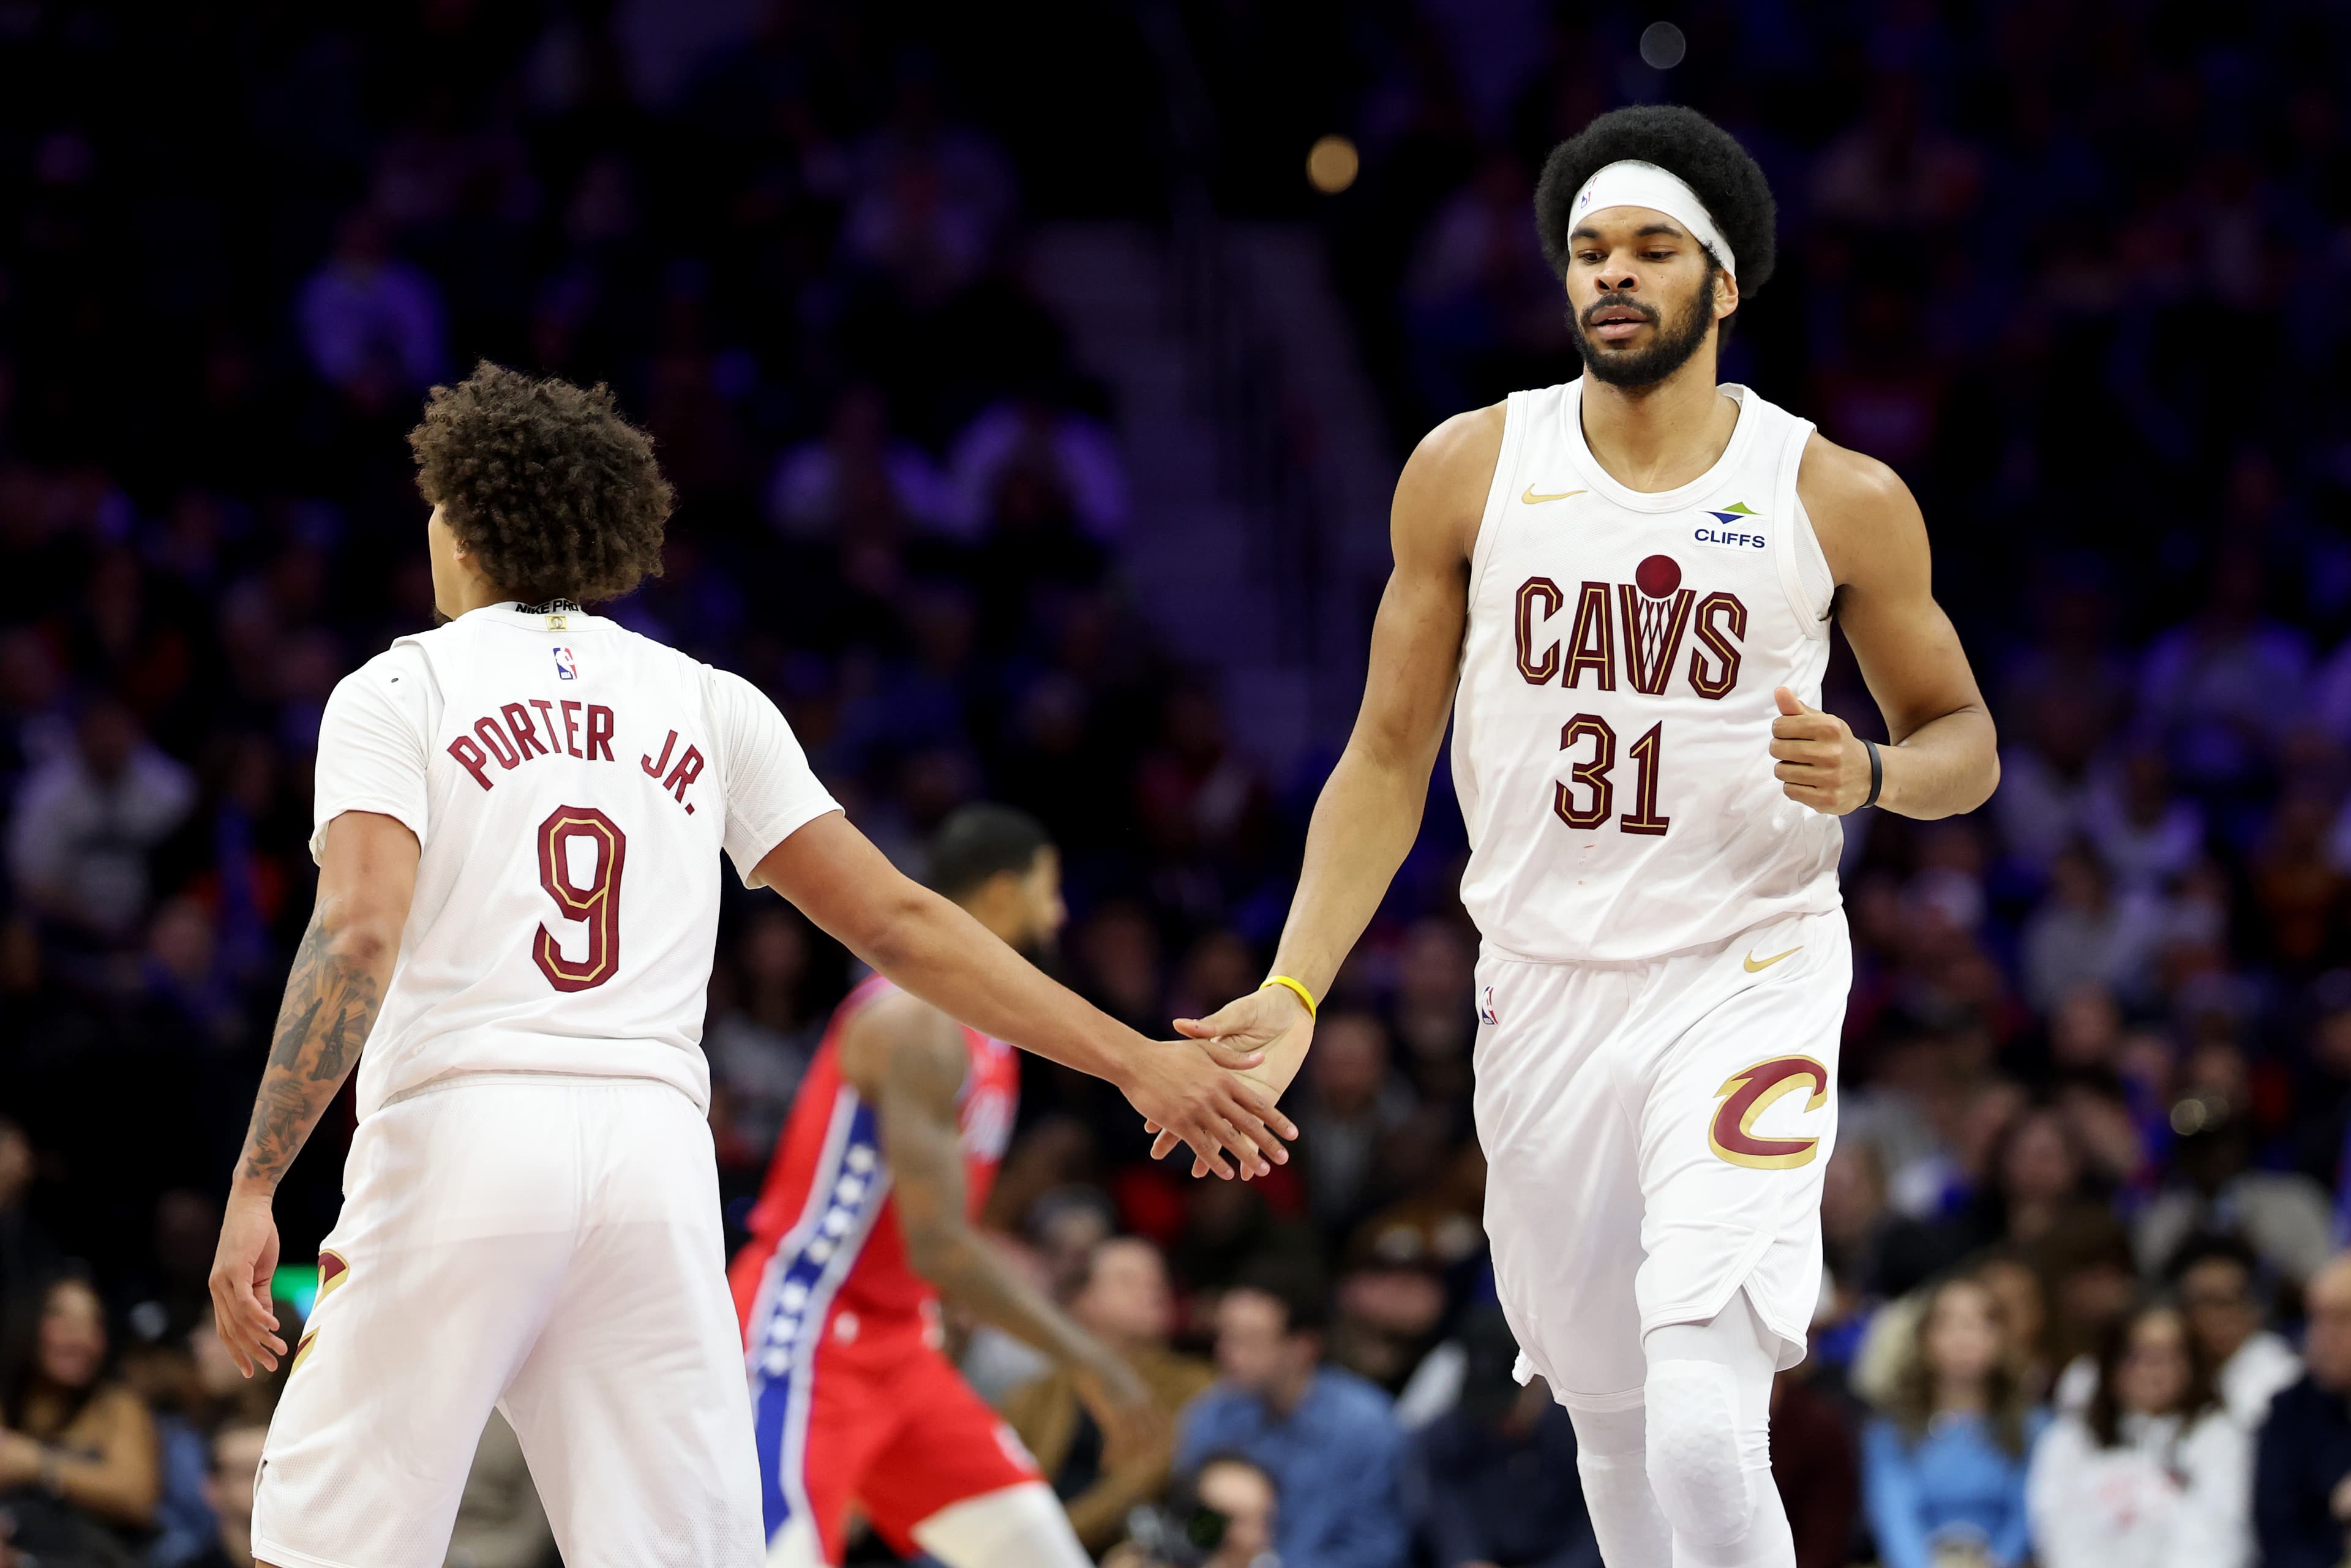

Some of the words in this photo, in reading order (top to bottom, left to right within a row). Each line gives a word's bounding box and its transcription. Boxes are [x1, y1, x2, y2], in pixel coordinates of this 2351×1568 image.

[1694, 528, 1765, 548] CLIFFS
[515, 602, 550, 614] NIKE
[552, 599, 579, 612] PRO
[1515, 576, 1748, 700] CAVS
[446, 699, 615, 791] PORTER
[640, 729, 704, 816] JR.
[1554, 713, 1670, 836] 31
[532, 805, 626, 993] 9
[1708, 1054, 1828, 1170] C
